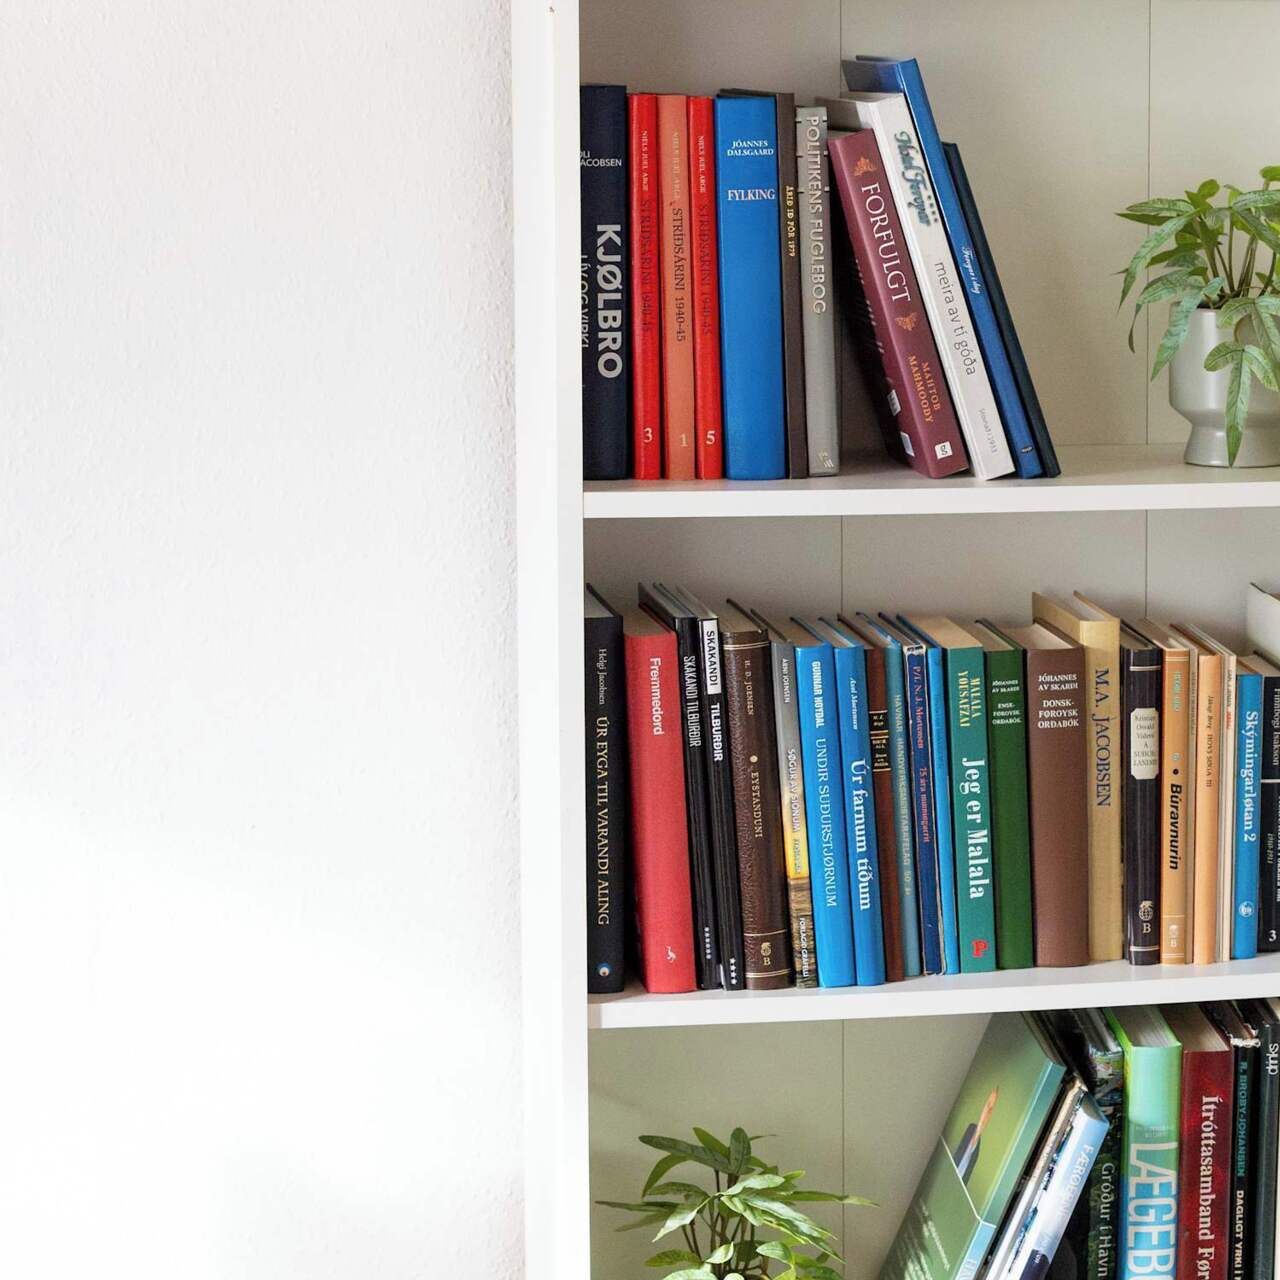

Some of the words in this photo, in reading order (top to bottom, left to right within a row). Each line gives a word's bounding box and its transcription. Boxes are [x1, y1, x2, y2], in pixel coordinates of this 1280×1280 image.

[580, 158, 622, 167] ACOBSEN
[727, 148, 774, 157] DALSGAARD
[806, 116, 822, 214] POLITIKENS
[727, 189, 776, 201] FYLKING
[861, 182, 911, 302] FORFULGT
[810, 220, 826, 313] FUGLEBOG
[596, 224, 623, 378] KJØLBRO
[675, 297, 686, 342] 1940-45
[934, 262, 955, 304] meira
[947, 308, 960, 324] av
[954, 340, 977, 376] góða
[908, 354, 934, 423] MAHMOODY
[643, 427, 653, 443] 3
[680, 434, 688, 446] 1
[705, 430, 716, 445] 5
[597, 648, 607, 670] Helgi
[683, 656, 698, 699] SKAKANDI
[706, 630, 718, 686] SKAKANDI
[811, 661, 823, 695] GUNNAR
[1038, 672, 1077, 682] JÓHANNES
[649, 657, 665, 736] Fremmedord
[958, 671, 971, 727] YOUSAFZAI
[969, 677, 982, 718] MALALA
[1038, 683, 1048, 691] AV
[1042, 699, 1074, 707] DONSK-
[596, 716, 610, 738] ÚR
[895, 694, 904, 732] HAVNAR
[1038, 709, 1079, 718] FØROYSK
[596, 742, 608, 778] EYGA
[815, 738, 829, 781] UNDIR
[851, 759, 870, 787] Úr
[959, 757, 985, 795] Jeg
[1092, 713, 1118, 807] JACOBSEN
[1240, 711, 1259, 830] Skýmingarløtan
[597, 781, 608, 806] TIL
[966, 800, 982, 823] er
[597, 808, 609, 874] VARANDI
[853, 789, 870, 852] farnum
[1169, 782, 1183, 870] Búravnurin
[1243, 833, 1256, 842] 2
[857, 858, 873, 911] tíðum
[967, 829, 990, 899] Malala
[1142, 923, 1151, 933] B
[1269, 930, 1277, 942] 3
[1237, 1075, 1248, 1177] BROBY-JOHANSEN
[1199, 1095, 1223, 1240] Ítróttasamband
[1099, 1163, 1115, 1220] Gróður
[1235, 1190, 1244, 1239] DAGLIGT
[1097, 1235, 1111, 1277] Havn
[1234, 1241, 1243, 1268] YRKI
